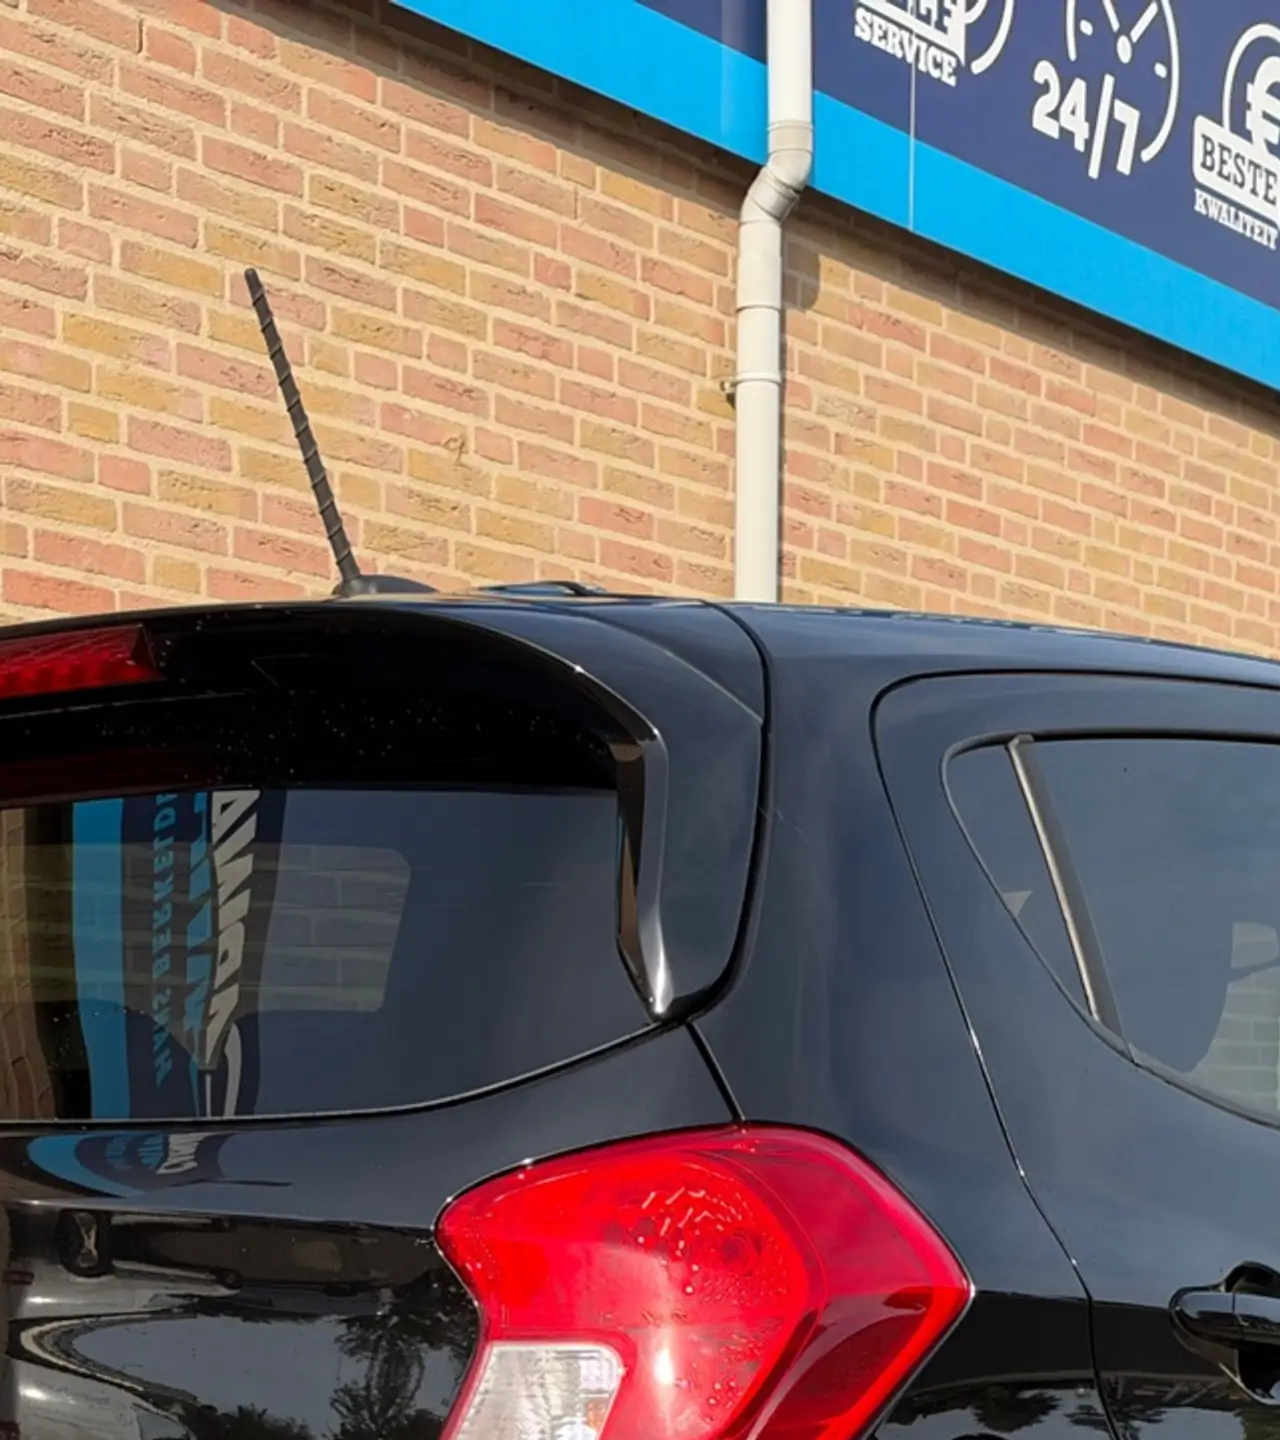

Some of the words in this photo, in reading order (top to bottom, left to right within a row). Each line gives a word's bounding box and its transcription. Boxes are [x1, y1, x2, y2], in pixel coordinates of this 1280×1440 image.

[854, 6, 957, 87] SERVICE
[1032, 60, 1140, 179] 24/7
[1200, 133, 1278, 207] BESTE
[1194, 188, 1280, 250] KWALITEIT
